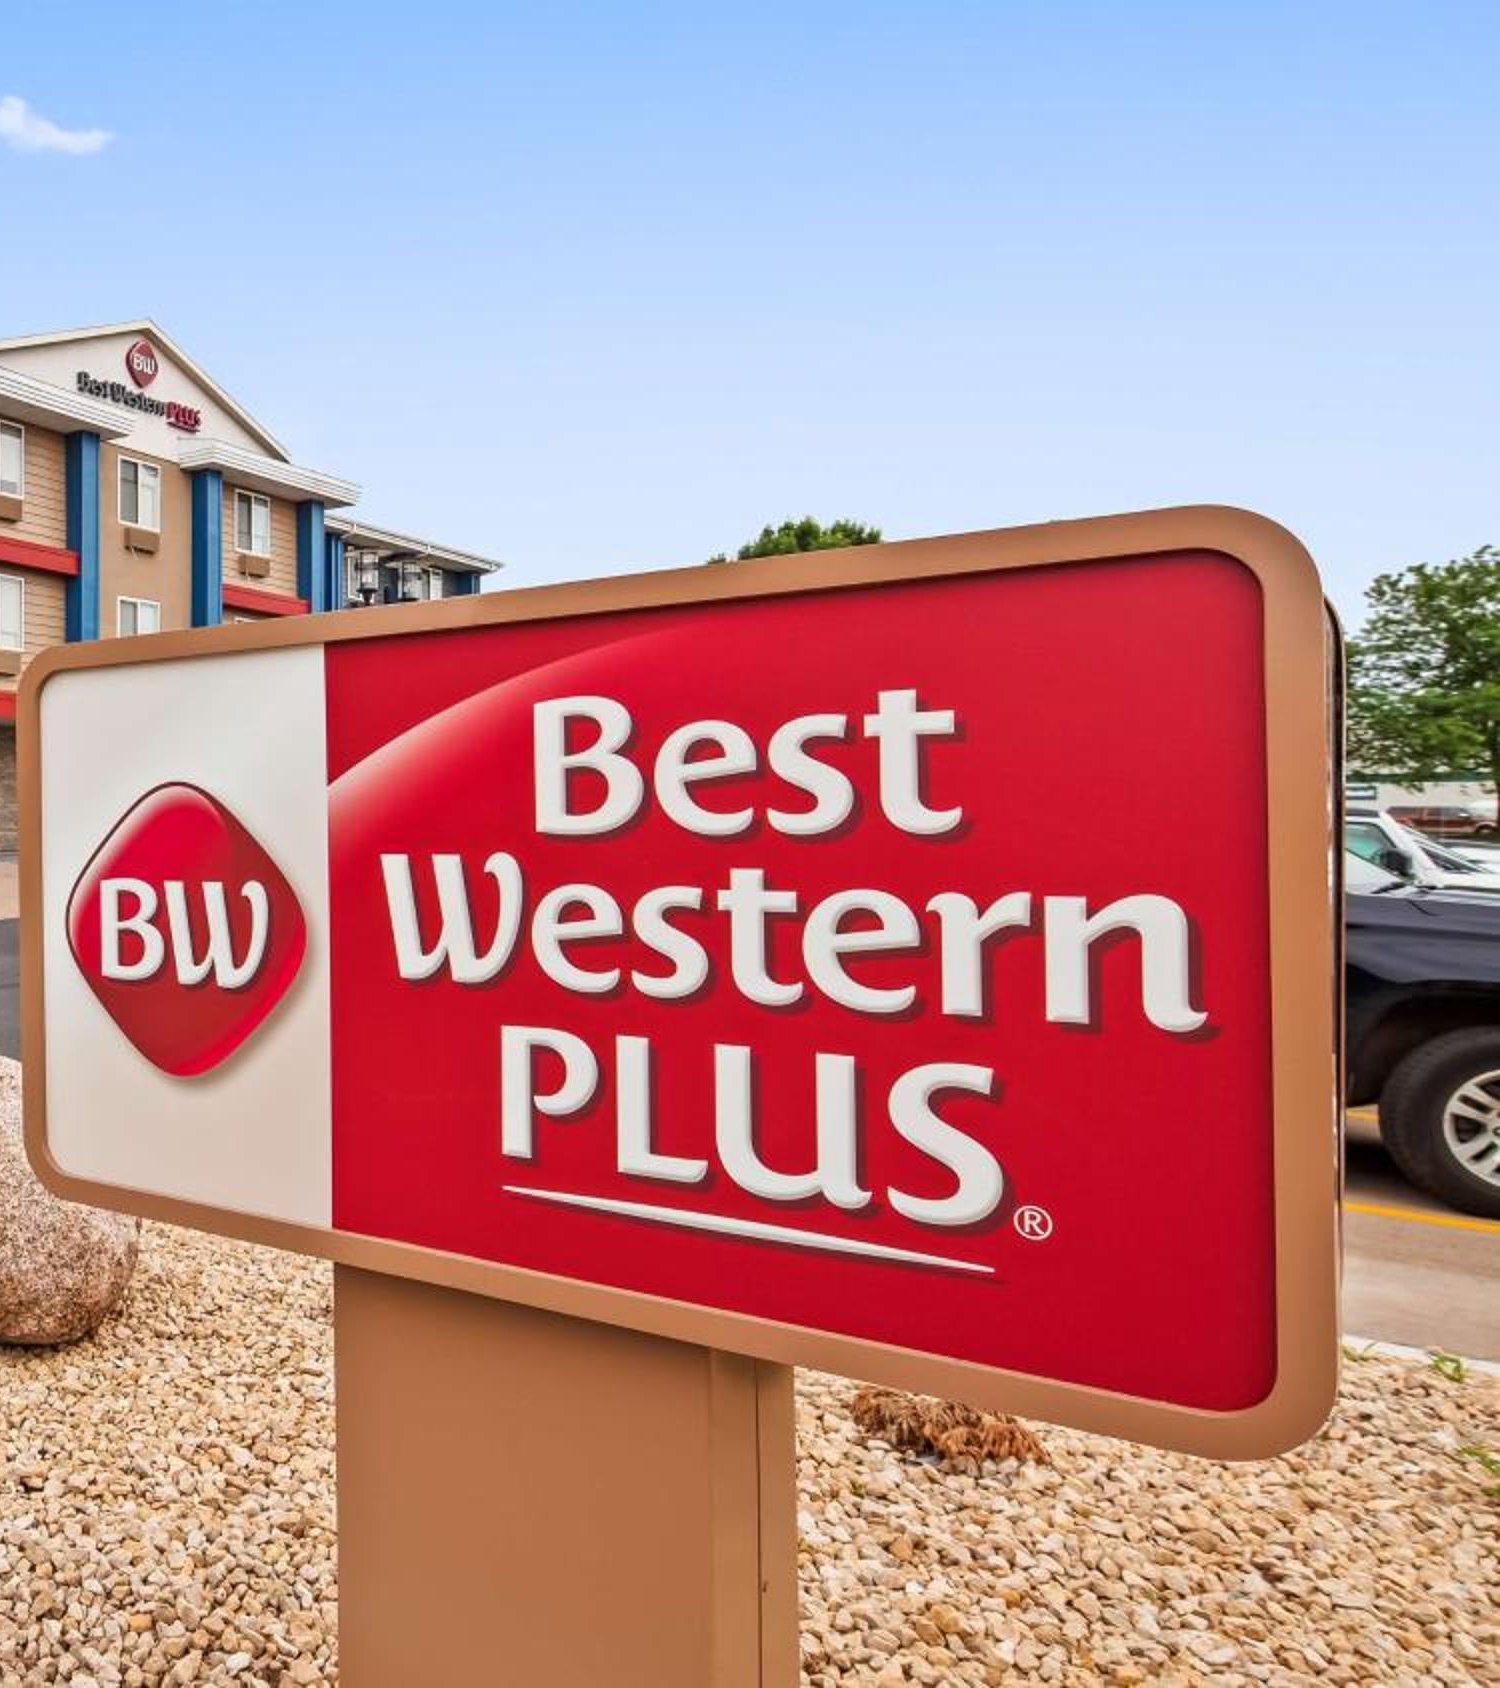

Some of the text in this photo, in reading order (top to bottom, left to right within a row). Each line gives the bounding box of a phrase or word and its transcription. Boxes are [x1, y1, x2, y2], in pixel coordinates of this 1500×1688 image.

[77, 371, 201, 428] Best Western PLUS
[132, 353, 155, 374] BW
[533, 689, 963, 836] Best
[99, 877, 269, 989] BW
[380, 851, 1208, 1033] Western
[501, 1025, 1004, 1226] PLUS
